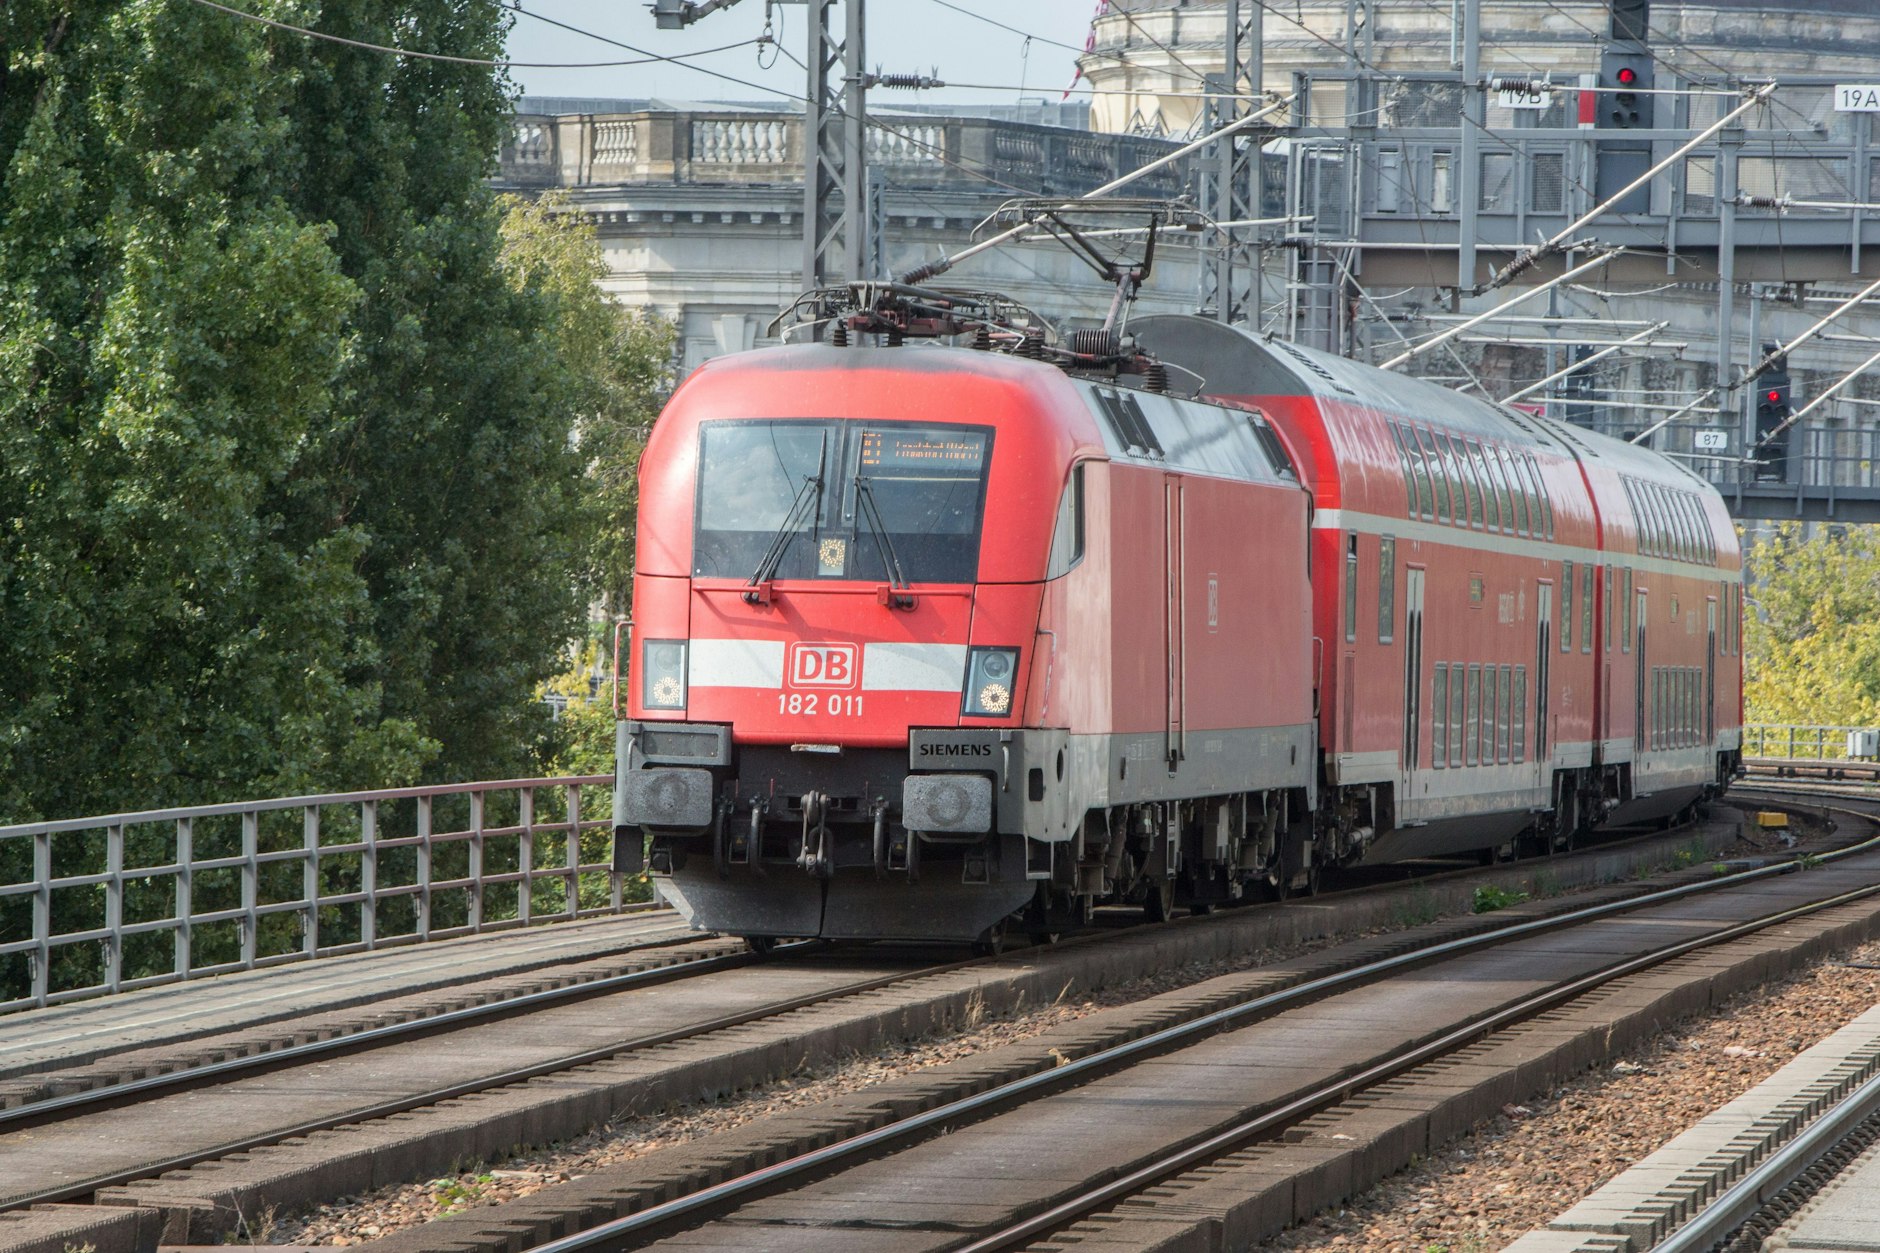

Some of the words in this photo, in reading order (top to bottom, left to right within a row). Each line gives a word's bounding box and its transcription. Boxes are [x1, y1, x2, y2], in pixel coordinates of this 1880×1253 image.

[1842, 90, 1879, 107] 19A
[1704, 434, 1719, 446] 87
[798, 650, 848, 680] DB
[778, 693, 817, 715] 182
[827, 694, 863, 717] 011
[920, 743, 992, 757] SIEMENS
